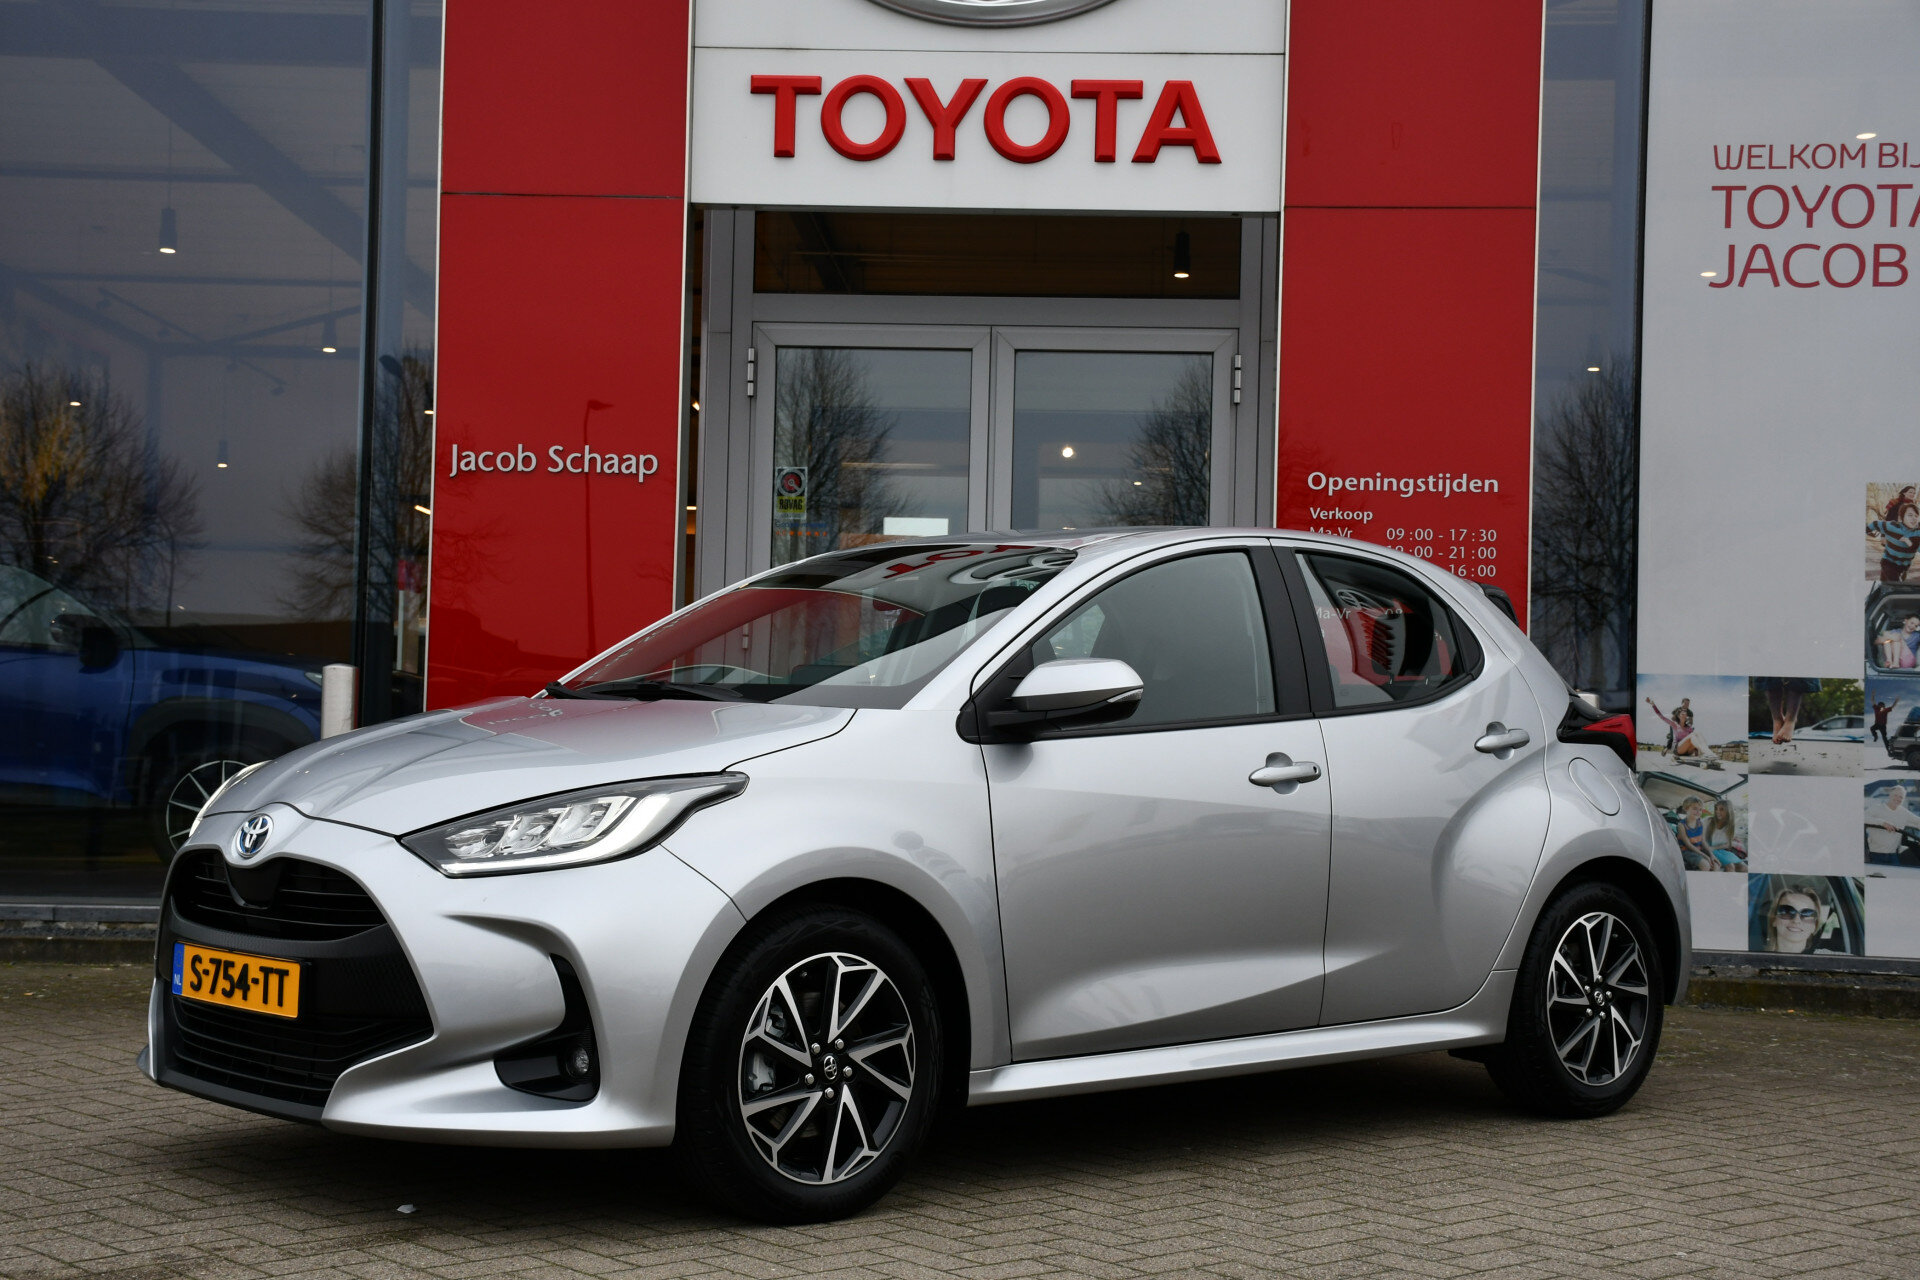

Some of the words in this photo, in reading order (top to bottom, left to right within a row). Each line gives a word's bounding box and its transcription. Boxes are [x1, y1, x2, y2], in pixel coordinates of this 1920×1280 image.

[750, 74, 1222, 164] TOYOTA
[1713, 143, 1867, 170] WELKOM
[1711, 183, 1920, 230] TOYOT
[1708, 243, 1909, 288] JACOB
[449, 443, 537, 478] Jacob
[547, 445, 659, 483] Schaap
[1307, 471, 1499, 498] Openingstijden
[1310, 507, 1373, 524] Verkoop
[174, 973, 182, 986] NL
[190, 954, 290, 1008] S-754-TT
